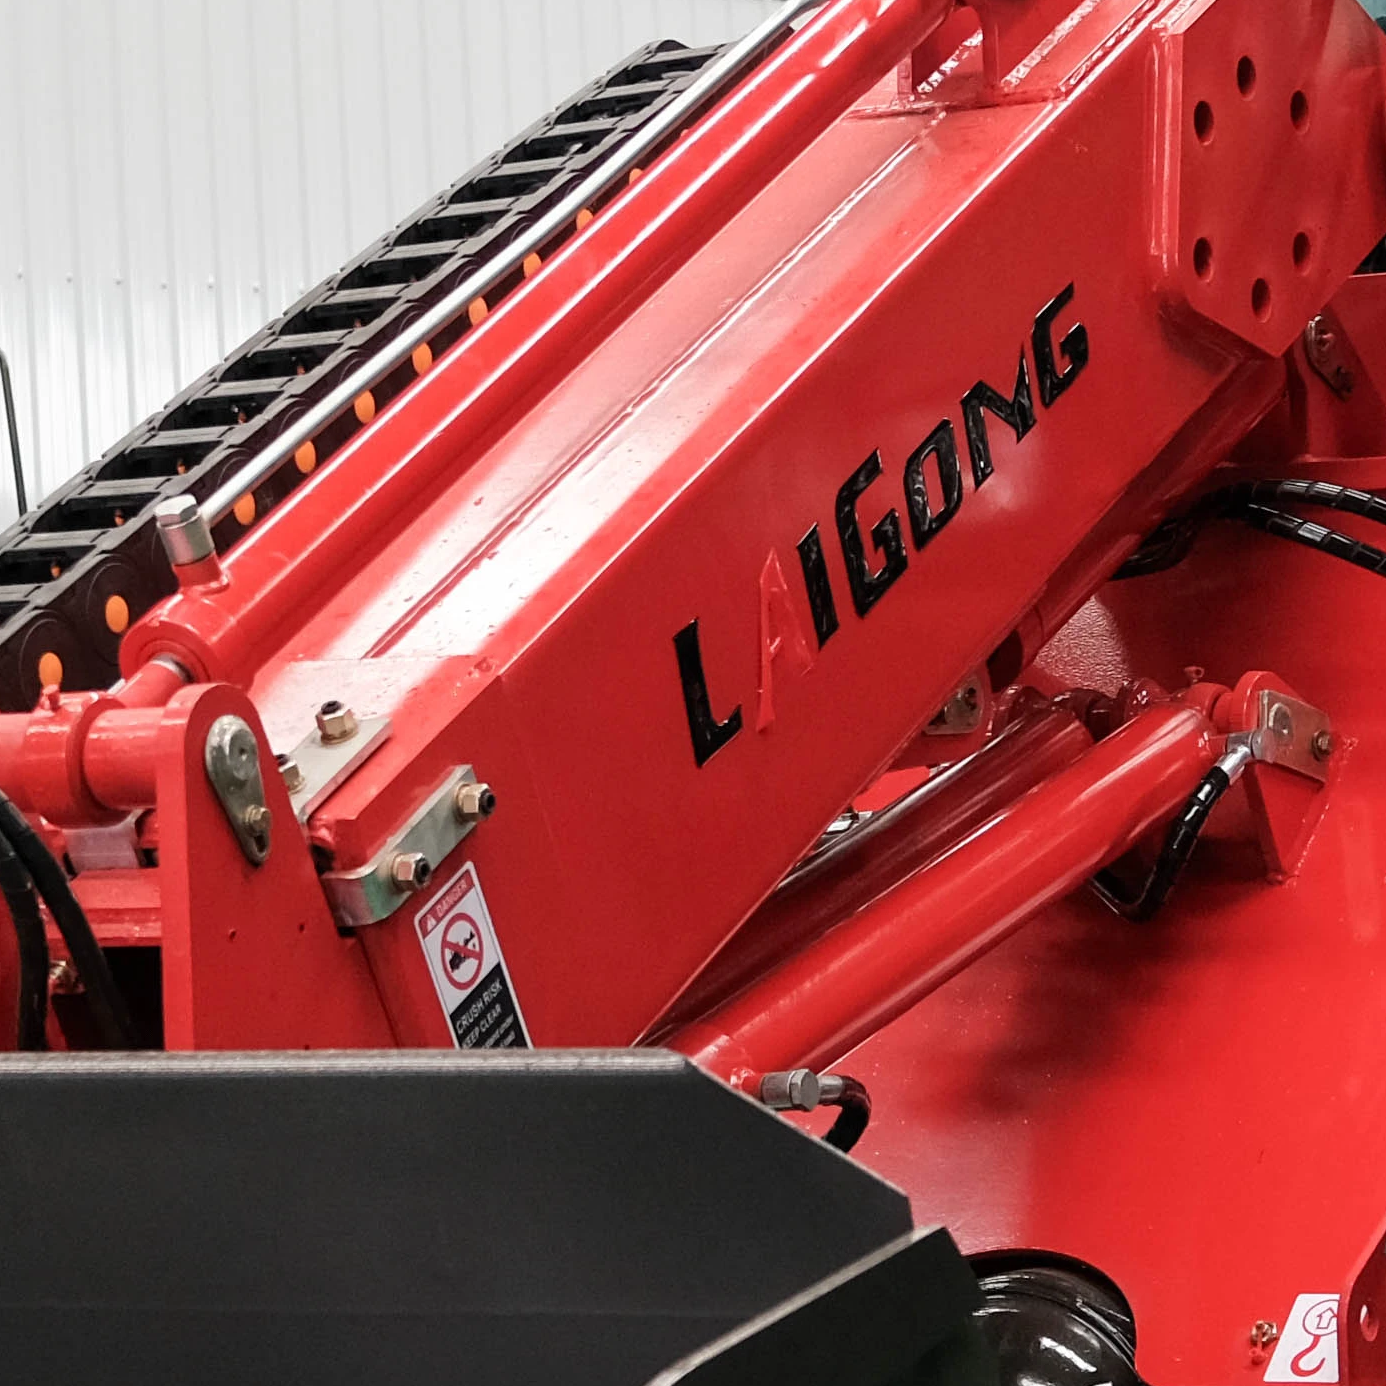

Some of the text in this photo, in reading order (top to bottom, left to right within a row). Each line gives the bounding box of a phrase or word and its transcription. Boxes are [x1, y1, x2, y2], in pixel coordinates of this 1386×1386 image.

[673, 282, 1089, 768] LAIGONG
[436, 879, 467, 918] DANGER
[456, 998, 484, 1034] CRUSH
[483, 978, 503, 1005] RISK
[480, 1003, 502, 1032] CLEAR
